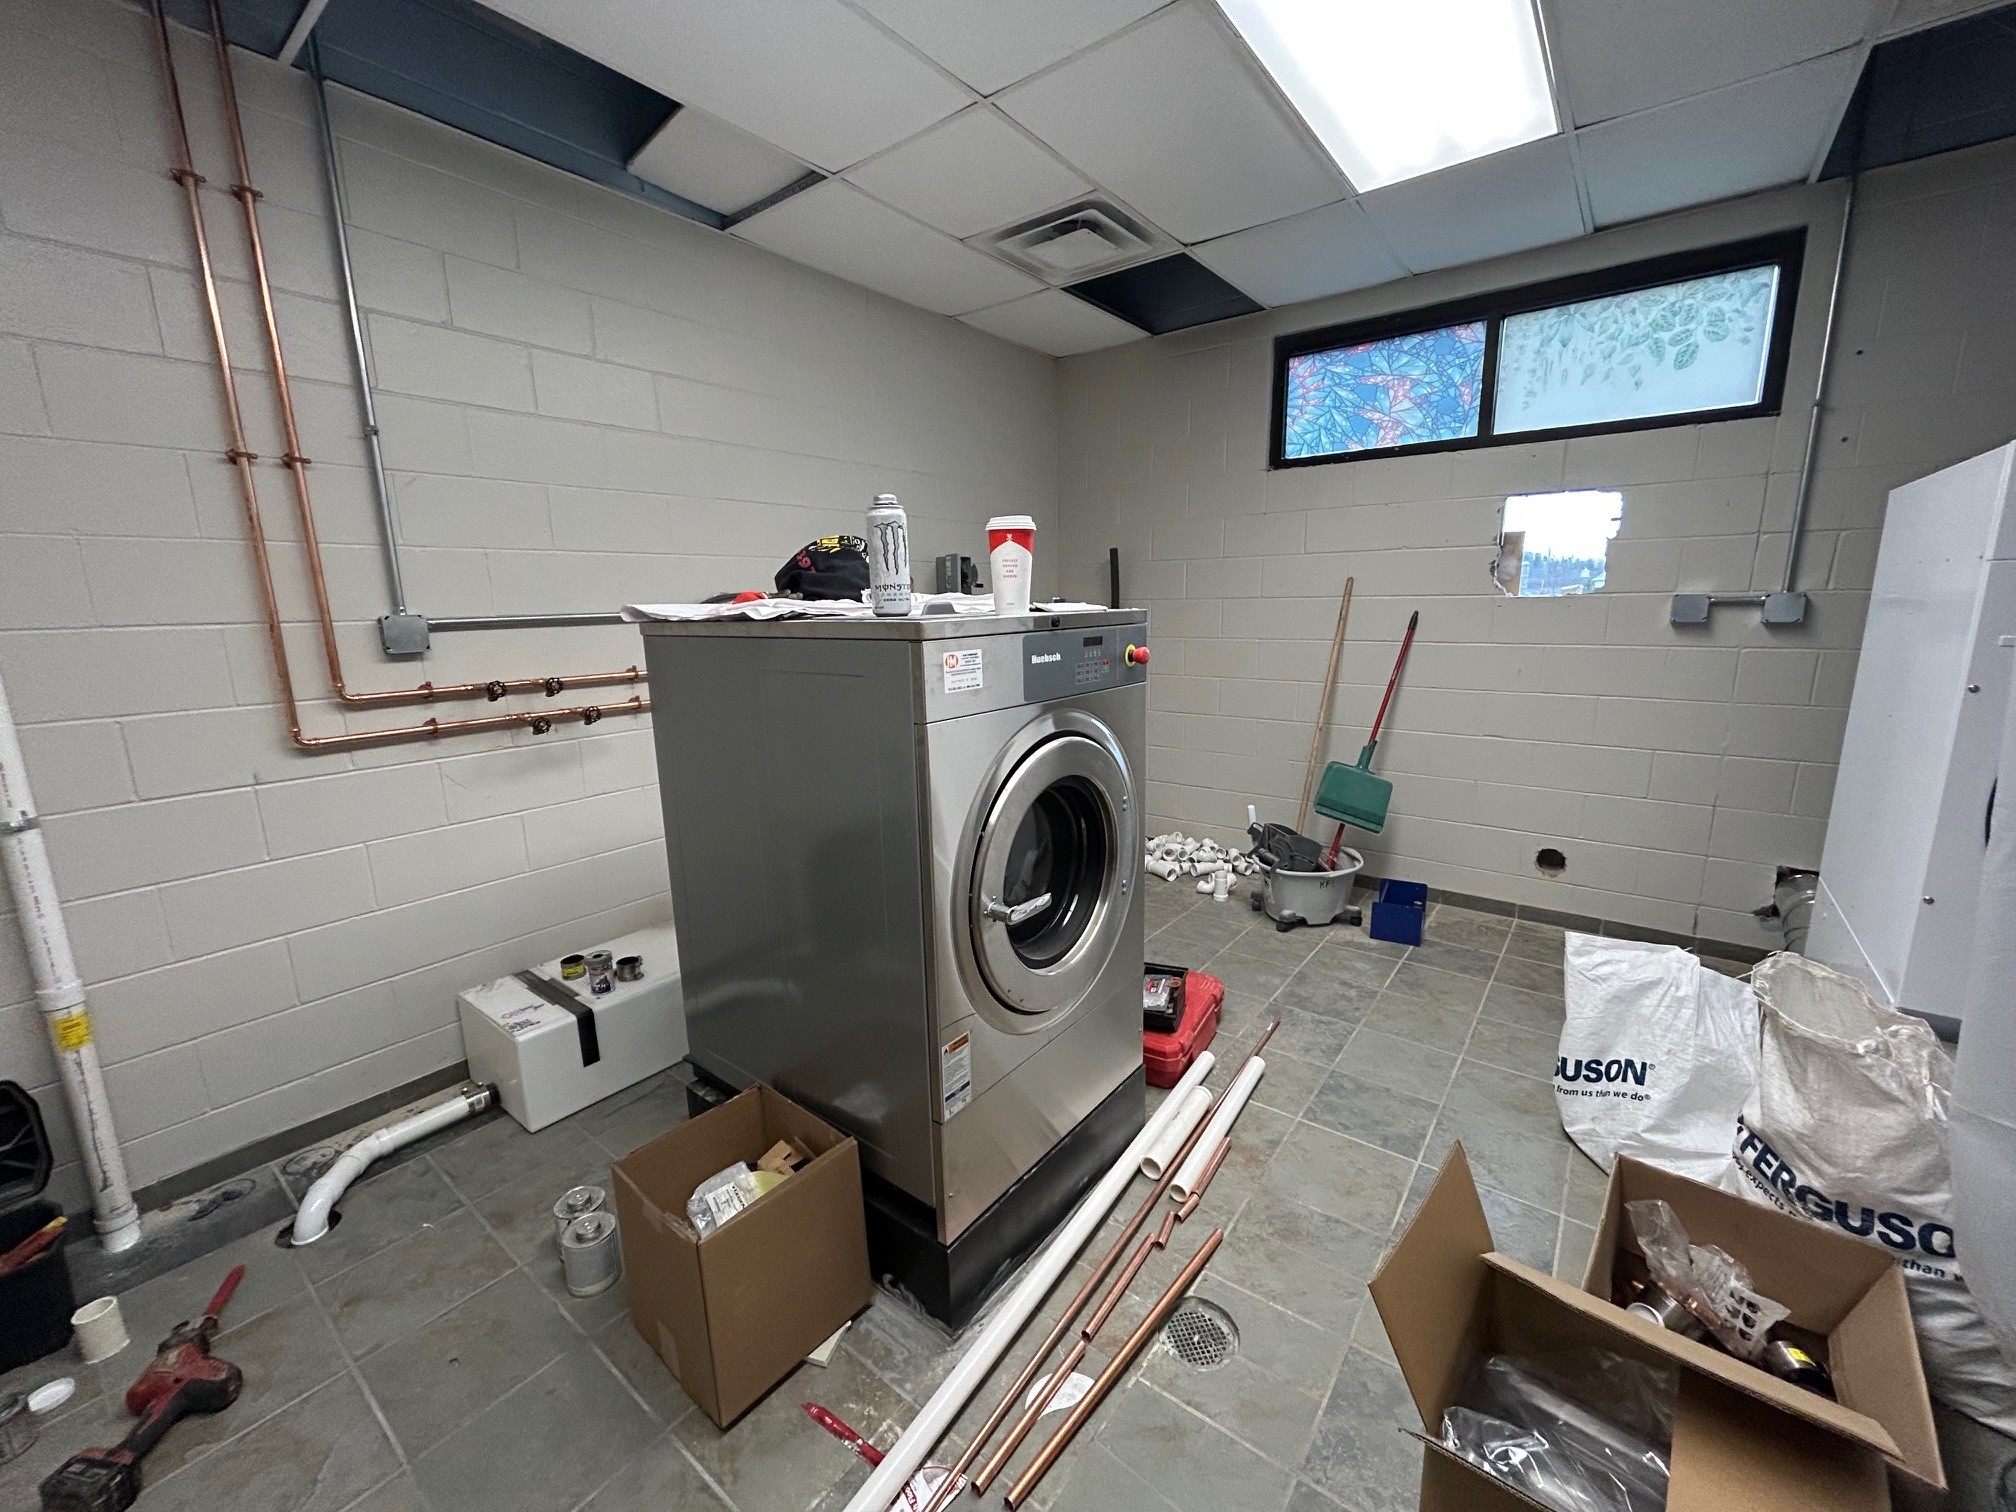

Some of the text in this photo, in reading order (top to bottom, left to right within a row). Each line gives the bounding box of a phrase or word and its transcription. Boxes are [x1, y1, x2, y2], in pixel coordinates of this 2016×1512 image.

[1031, 652, 1061, 664] Huebsch
[1556, 1085, 1579, 1096] from
[1581, 1089, 1593, 1097] us
[1613, 1090, 1628, 1099] we
[1630, 1092, 1644, 1102] do
[1745, 1170, 1785, 1211] expects
[1902, 1258, 1946, 1279] than
